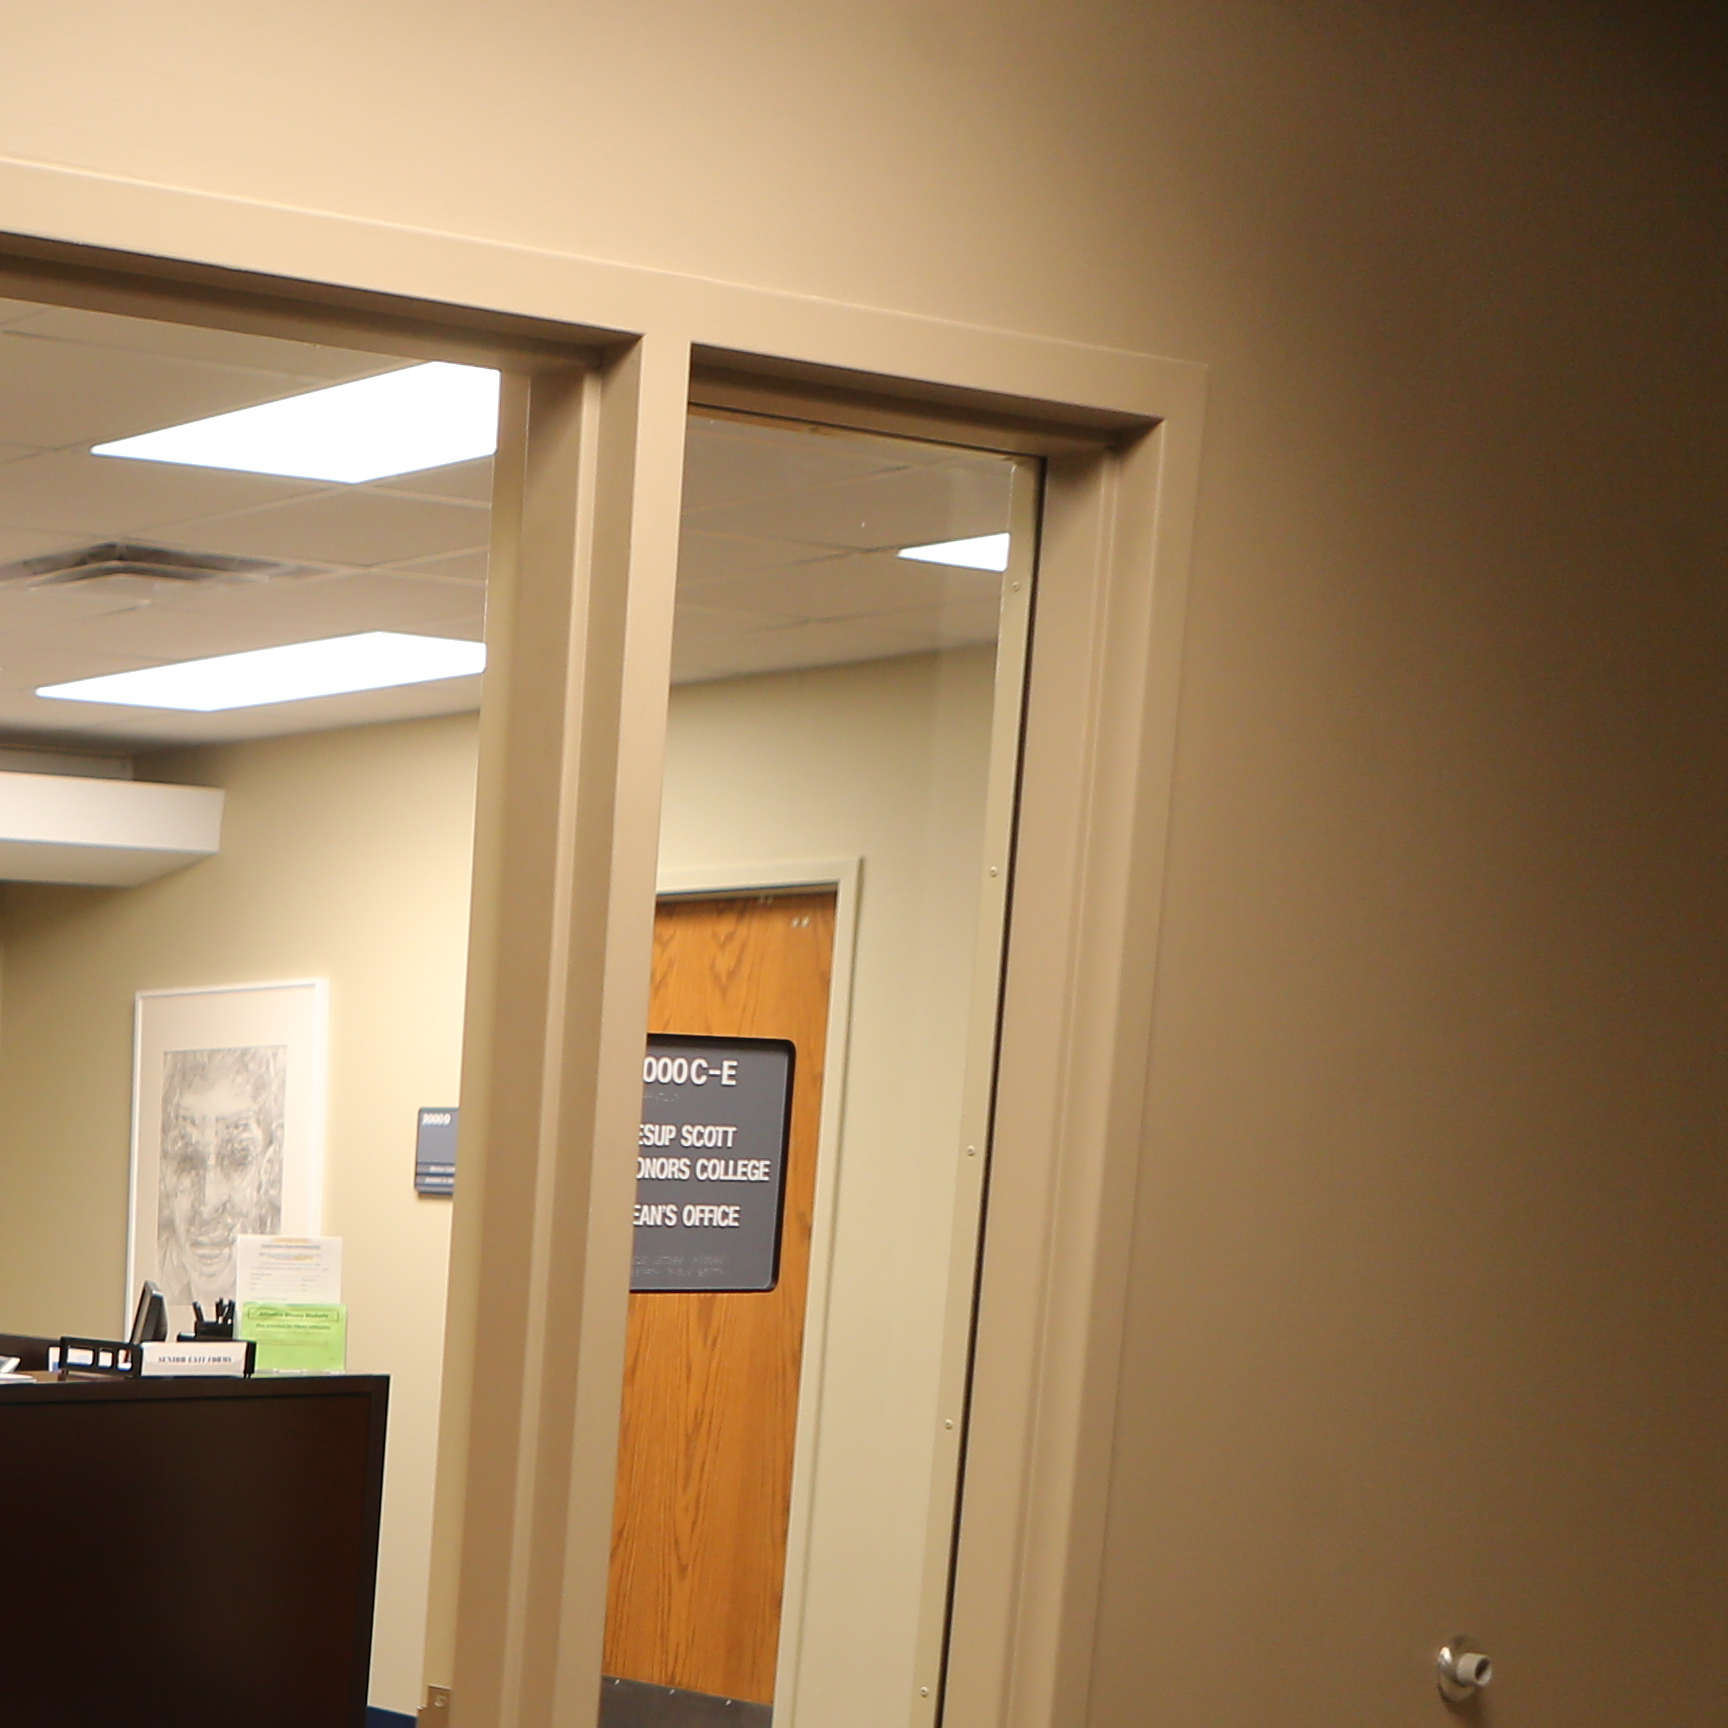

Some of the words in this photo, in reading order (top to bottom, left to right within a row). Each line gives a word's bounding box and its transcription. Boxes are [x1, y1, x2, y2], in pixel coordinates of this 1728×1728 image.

[680, 1125, 738, 1148] SCOTT
[695, 1159, 771, 1182] COLLEGE
[682, 1205, 741, 1228] OFFICE
